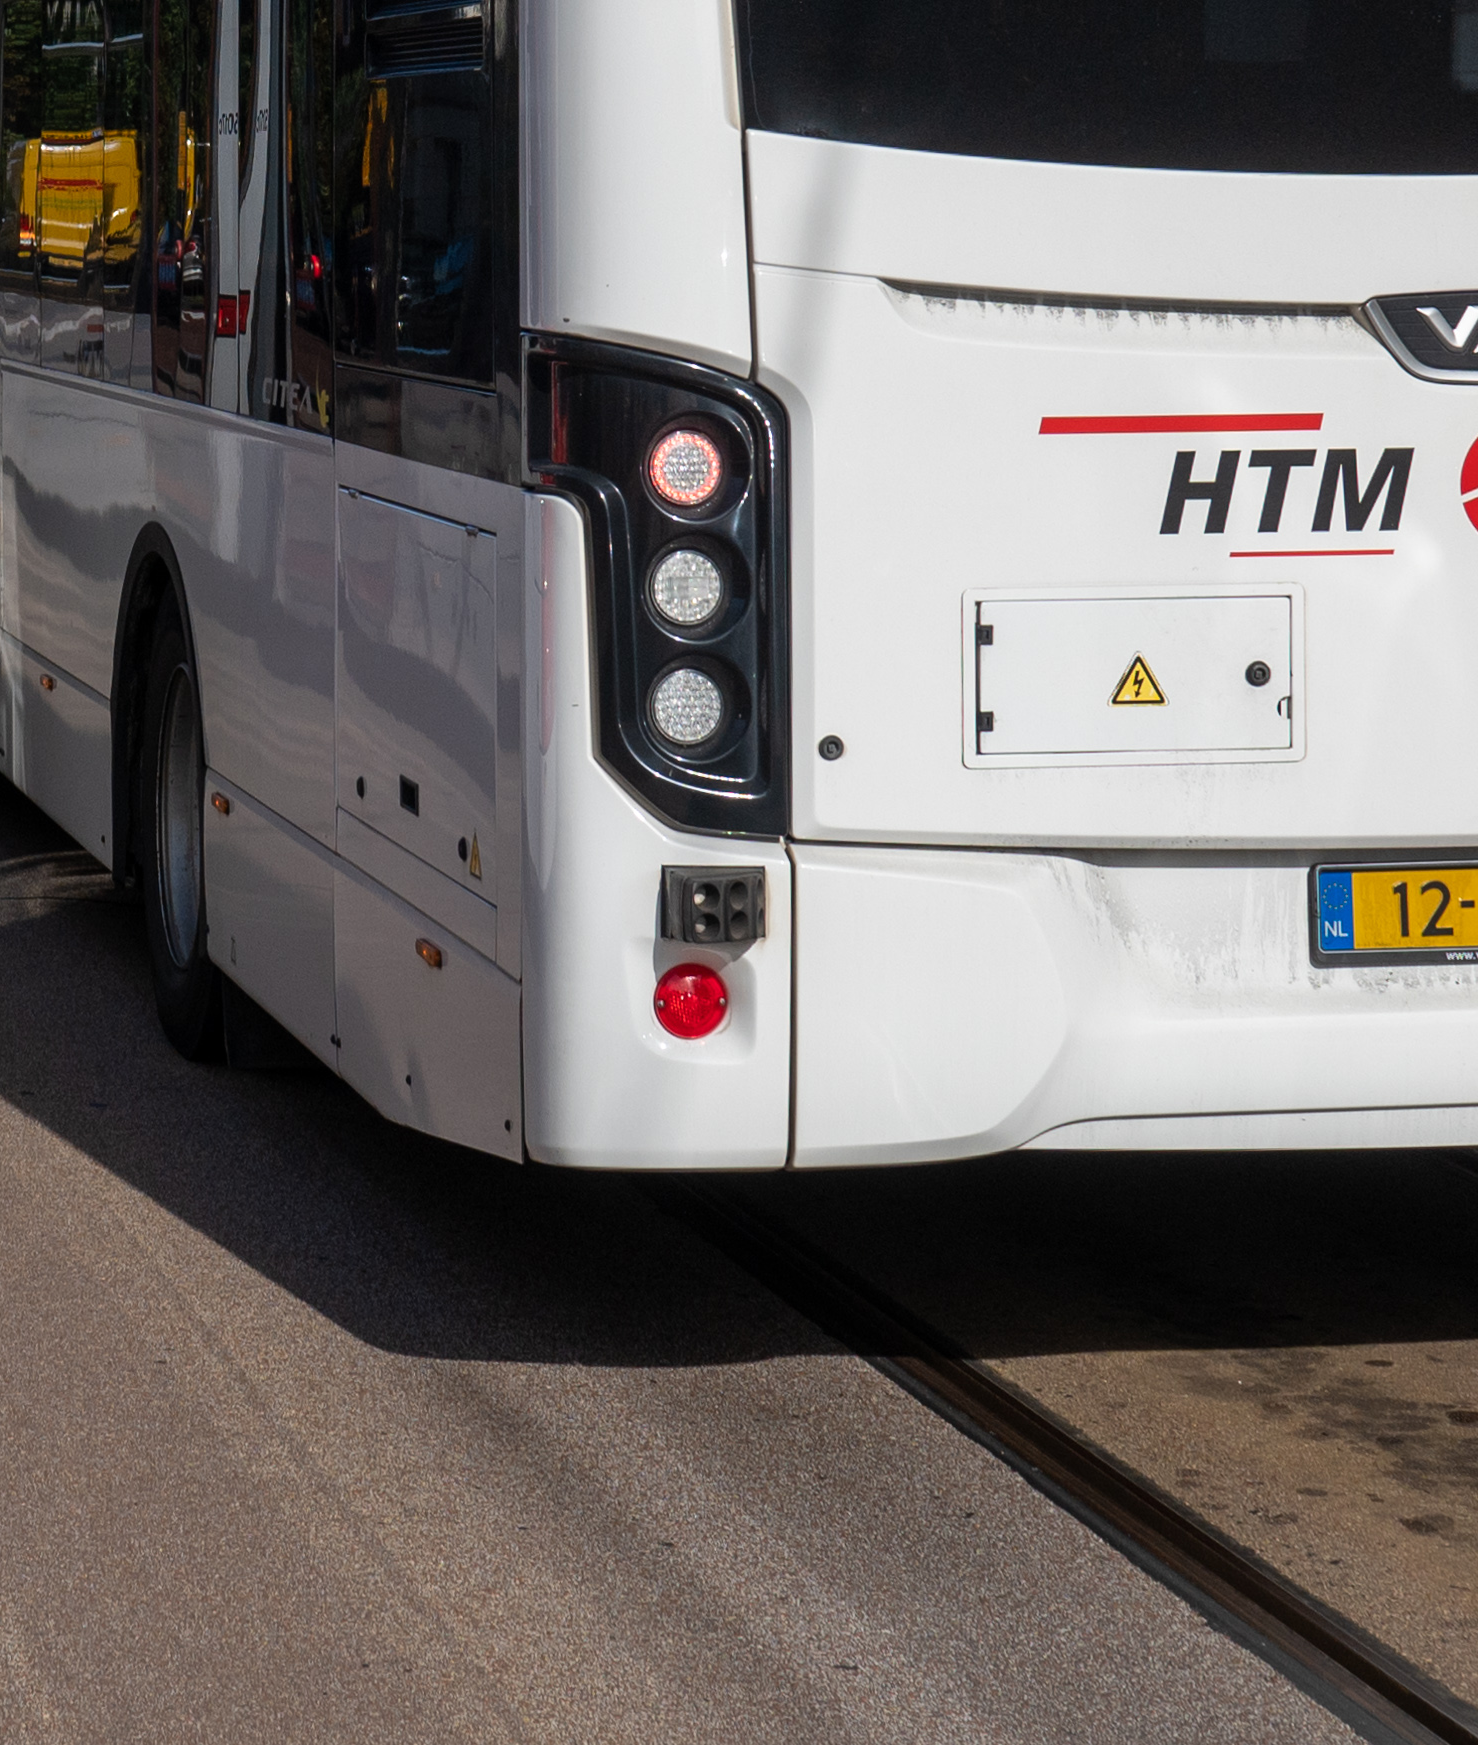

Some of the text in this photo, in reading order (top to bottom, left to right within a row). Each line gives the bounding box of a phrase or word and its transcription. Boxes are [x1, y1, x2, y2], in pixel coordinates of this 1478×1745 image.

[262, 376, 313, 414] CITEA
[1160, 447, 1415, 535] HTM
[1324, 920, 1348, 939] NL
